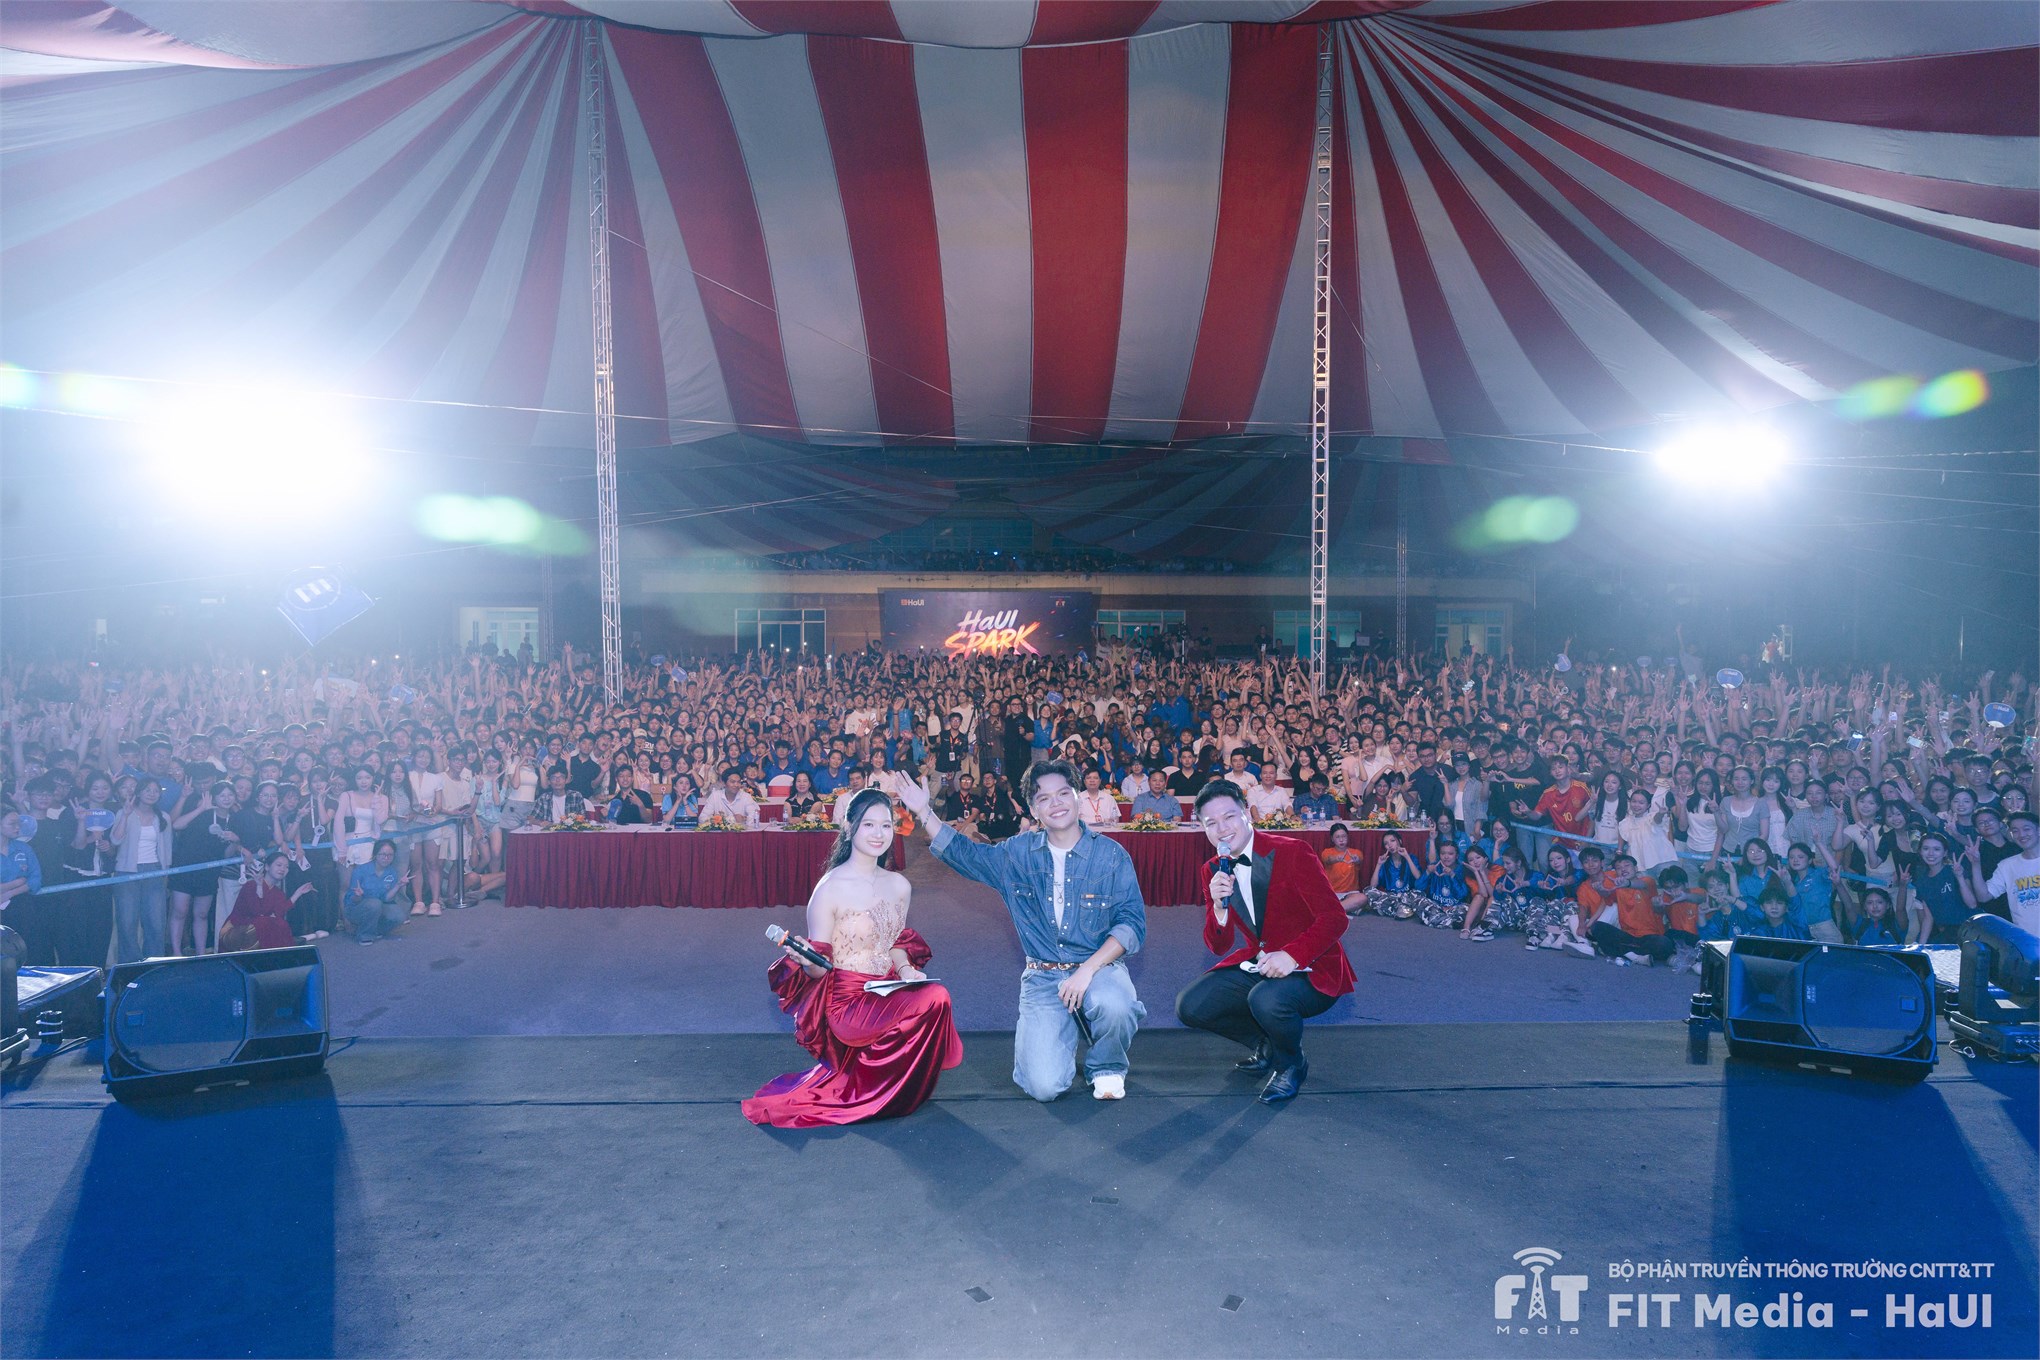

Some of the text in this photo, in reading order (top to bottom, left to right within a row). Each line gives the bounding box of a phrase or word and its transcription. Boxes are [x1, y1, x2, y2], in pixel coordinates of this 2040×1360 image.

[907, 598, 925, 606] HaUI
[957, 609, 1019, 634] HaUI
[944, 621, 1041, 661] SPARK
[1563, 811, 1573, 822] 10
